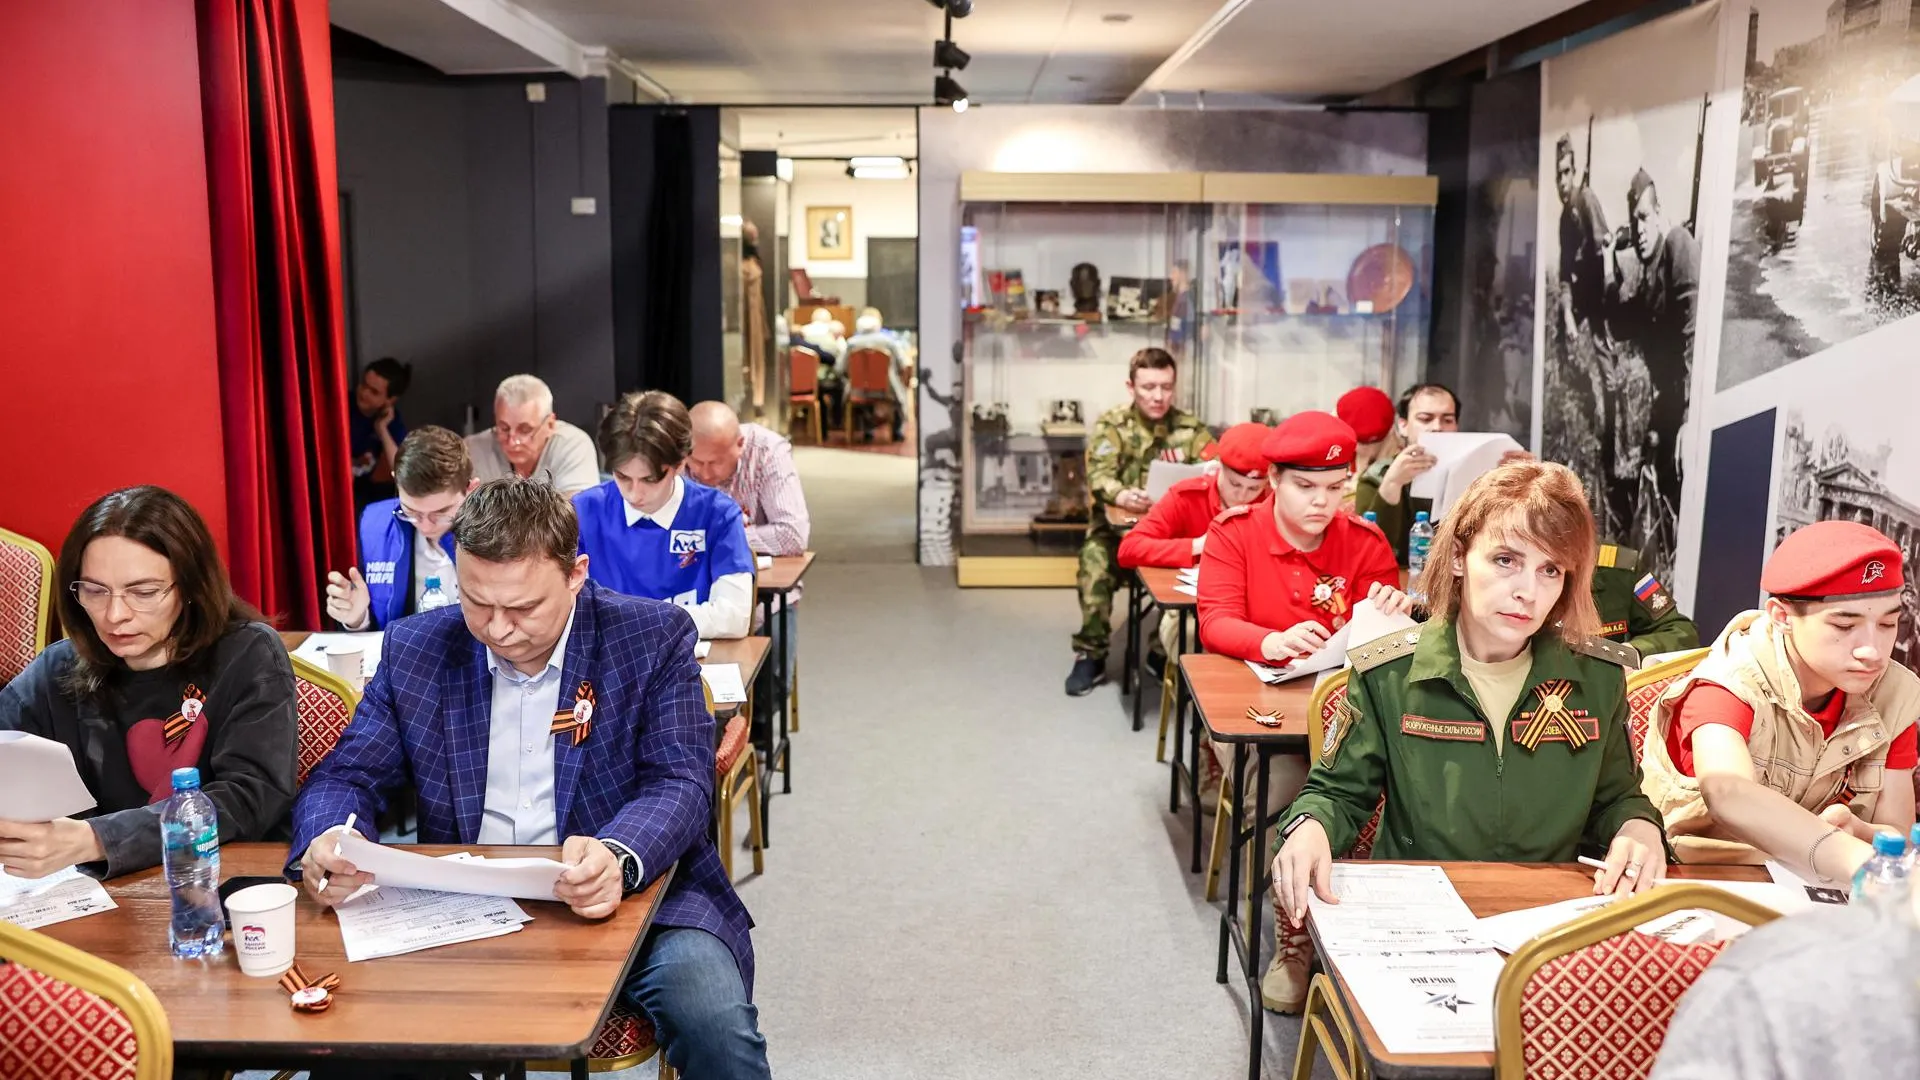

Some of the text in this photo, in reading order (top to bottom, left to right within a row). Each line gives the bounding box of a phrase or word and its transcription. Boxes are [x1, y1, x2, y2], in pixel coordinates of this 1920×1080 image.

[1405, 720, 1482, 736] ВООРУЖЕННЫЕ СИЛЫ РОССИИ
